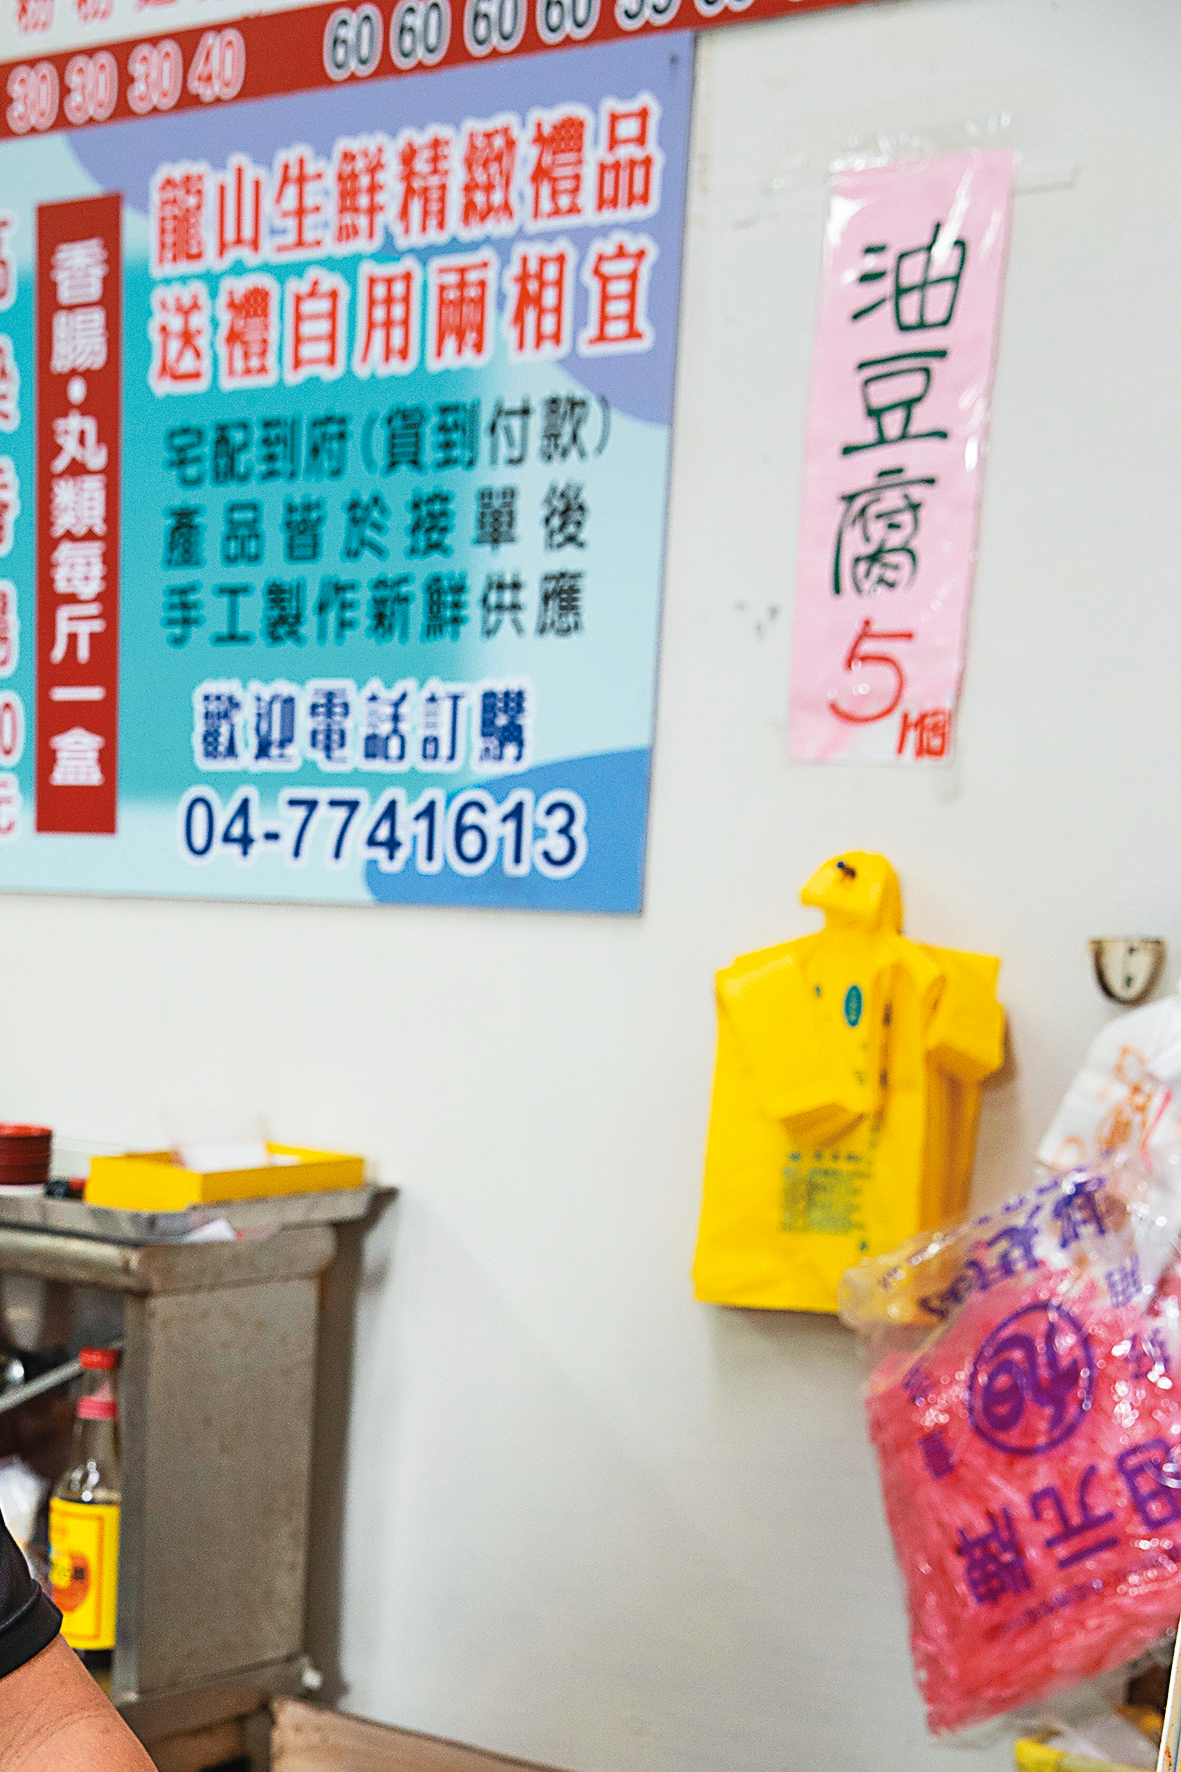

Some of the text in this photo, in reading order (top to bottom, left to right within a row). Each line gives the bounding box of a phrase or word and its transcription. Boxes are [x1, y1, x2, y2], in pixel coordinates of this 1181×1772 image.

[329, 13, 378, 73] 60
[395, 0, 446, 64] 60
[469, 0, 521, 51] 60
[10, 65, 56, 130] 30
[67, 55, 114, 120] 30
[131, 43, 179, 110] 30
[191, 32, 242, 98] 40
[157, 100, 655, 267] 龍山生鮮精緻禮品
[156, 241, 649, 386] 送禮自用兩相宜
[833, 222, 968, 596] 油豆腐
[163, 570, 586, 648] 手工製作新鮮供應
[201, 687, 528, 764] 歡迎電話訂購
[185, 796, 578, 867] 04-7741613
